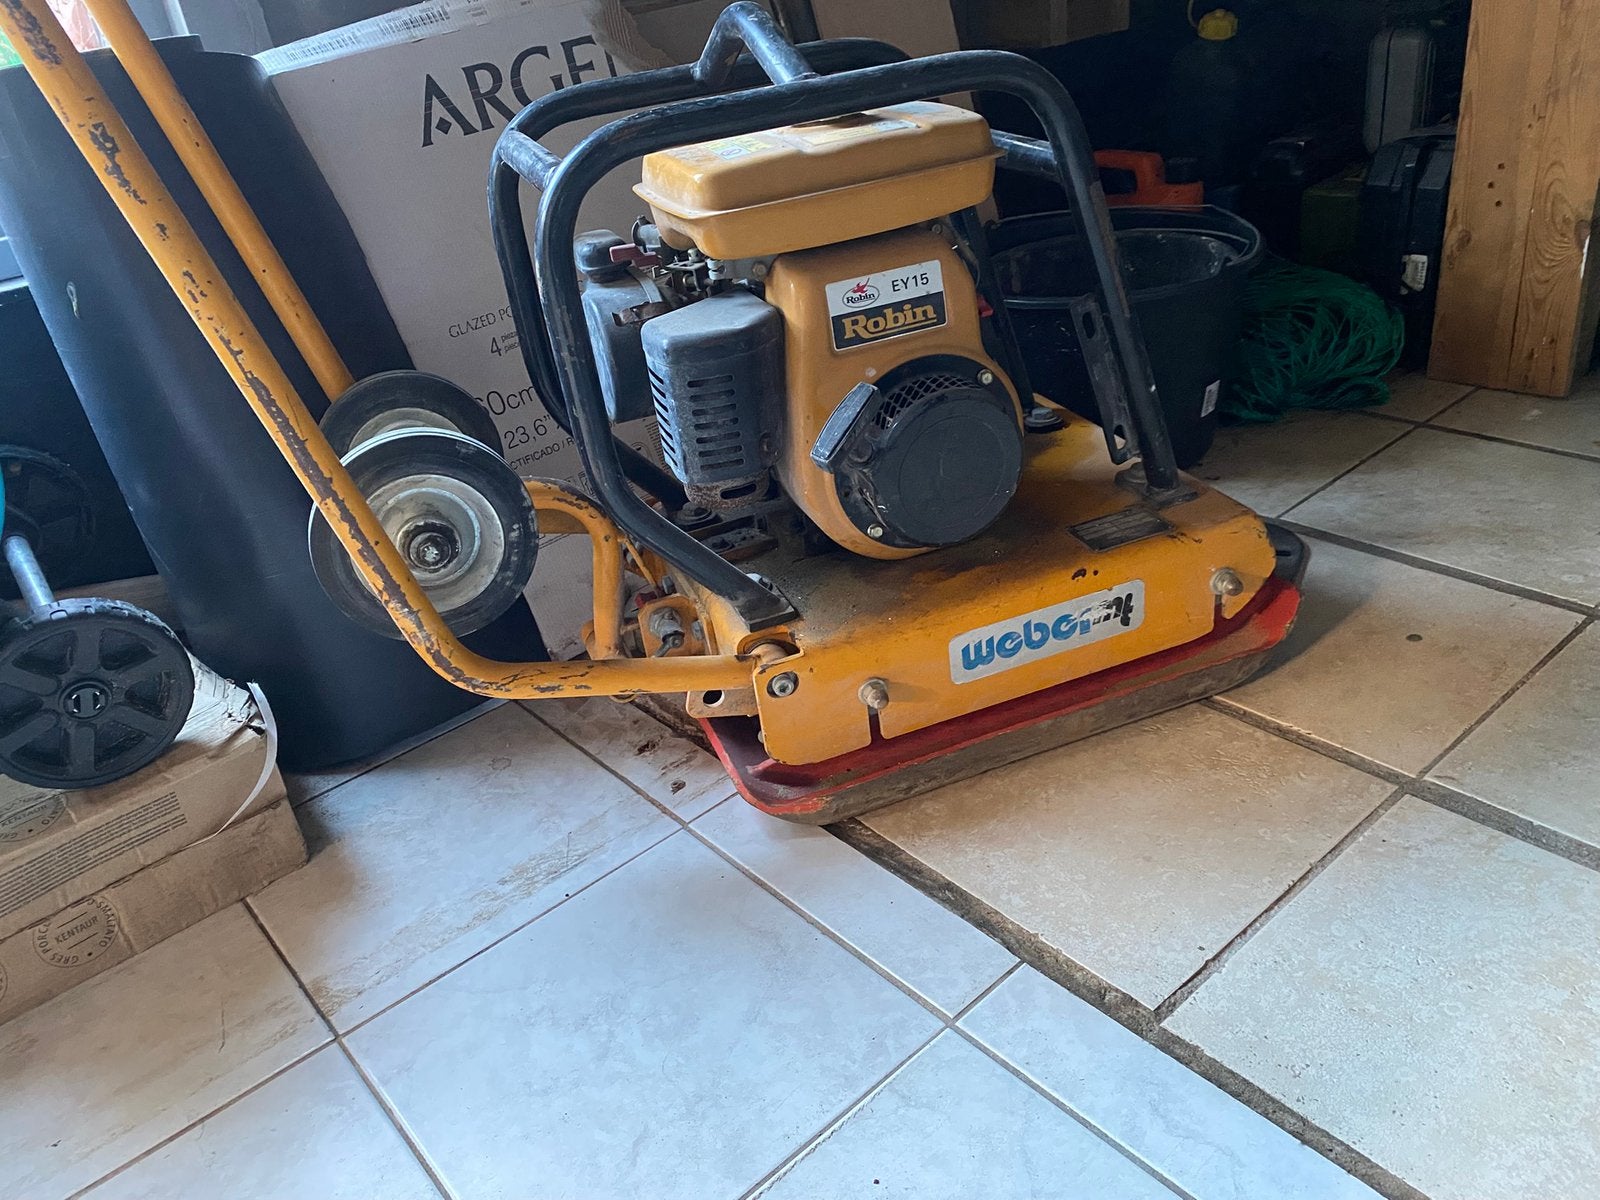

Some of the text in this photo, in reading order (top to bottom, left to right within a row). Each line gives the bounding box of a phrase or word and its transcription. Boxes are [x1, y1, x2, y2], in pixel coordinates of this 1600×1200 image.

[422, 36, 617, 147] ARGE
[892, 273, 929, 292] EY15
[845, 293, 876, 304] Robin
[449, 312, 497, 338] GLAZED
[842, 303, 937, 340] Robin
[490, 336, 502, 357] 4
[474, 386, 534, 415] 0cm
[510, 443, 560, 470] CTIFICADO
[54, 915, 99, 944] KENTAUR
[49, 952, 80, 965] GRES
